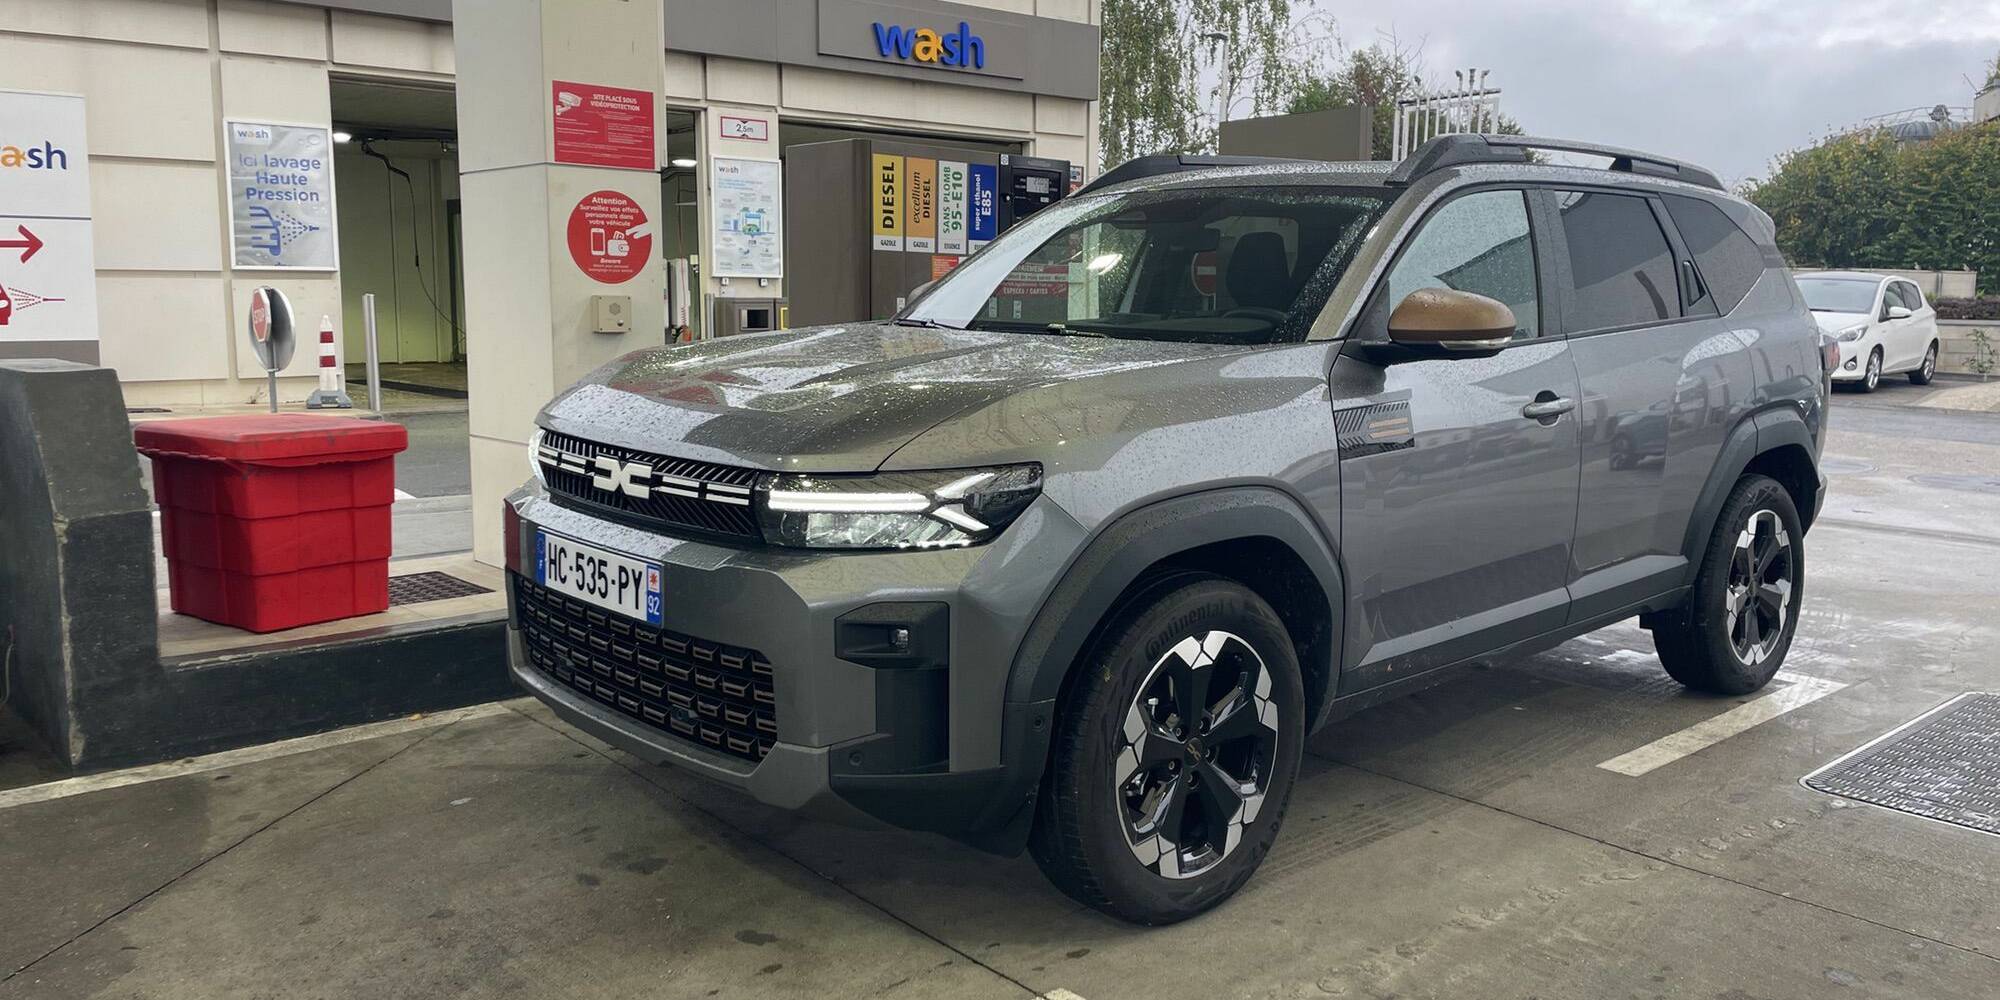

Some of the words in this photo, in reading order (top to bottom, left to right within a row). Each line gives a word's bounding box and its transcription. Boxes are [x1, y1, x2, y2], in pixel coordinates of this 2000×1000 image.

[872, 21, 985, 69] wash
[238, 129, 269, 139] wash
[0, 140, 67, 170] ash
[264, 154, 321, 171] lavage
[256, 171, 308, 186] Haute
[942, 166, 951, 203] PLOMB
[246, 187, 320, 202] Pression
[579, 203, 609, 212] Surveillez
[591, 196, 628, 206] Attention
[882, 162, 895, 229] DIESEL
[911, 171, 921, 224] excellium
[922, 179, 931, 219] DIESEL
[981, 190, 992, 217] E85
[942, 206, 951, 234] SANS
[647, 595, 660, 616] 92
[1145, 601, 1225, 660] Continental
